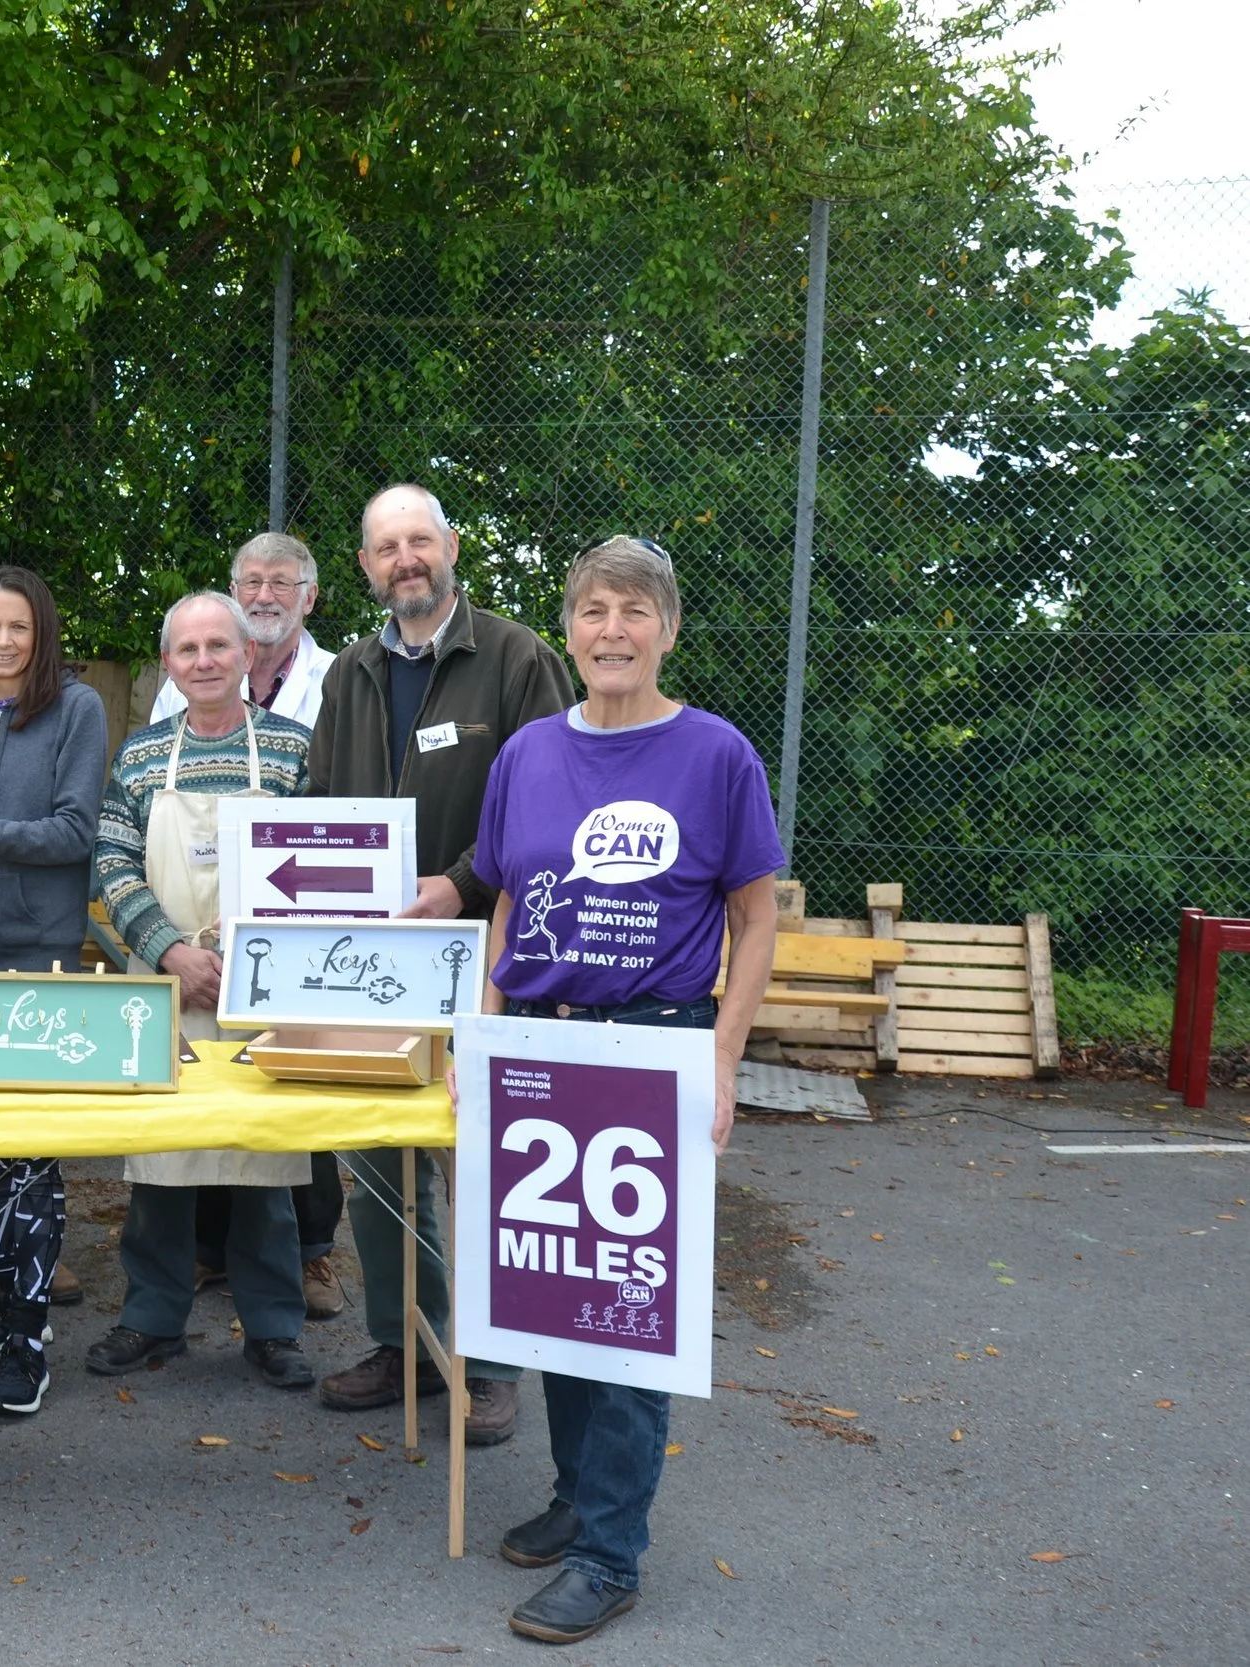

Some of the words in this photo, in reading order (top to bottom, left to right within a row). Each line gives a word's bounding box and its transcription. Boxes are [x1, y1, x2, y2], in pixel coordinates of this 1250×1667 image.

[421, 729, 449, 748] Nigel
[589, 814, 666, 833] Women
[584, 833, 664, 861] CAN
[584, 894, 628, 910] Women
[632, 899, 659, 914] only
[577, 911, 658, 928] MARATHON
[615, 930, 627, 943] st
[629, 932, 655, 946] john
[319, 935, 380, 984] keys
[563, 949, 580, 963] 28
[583, 951, 618, 966] MAY
[621, 955, 654, 968] 2017
[2, 989, 67, 1043] keys
[501, 1077, 551, 1090] MARATHON
[505, 1068, 534, 1078] Women
[534, 1071, 551, 1081] only
[507, 1088, 527, 1097] tipton
[535, 1091, 551, 1100] john
[499, 1118, 667, 1237] 26
[499, 1228, 668, 1288] MILES
[622, 1290, 650, 1300] CAN
